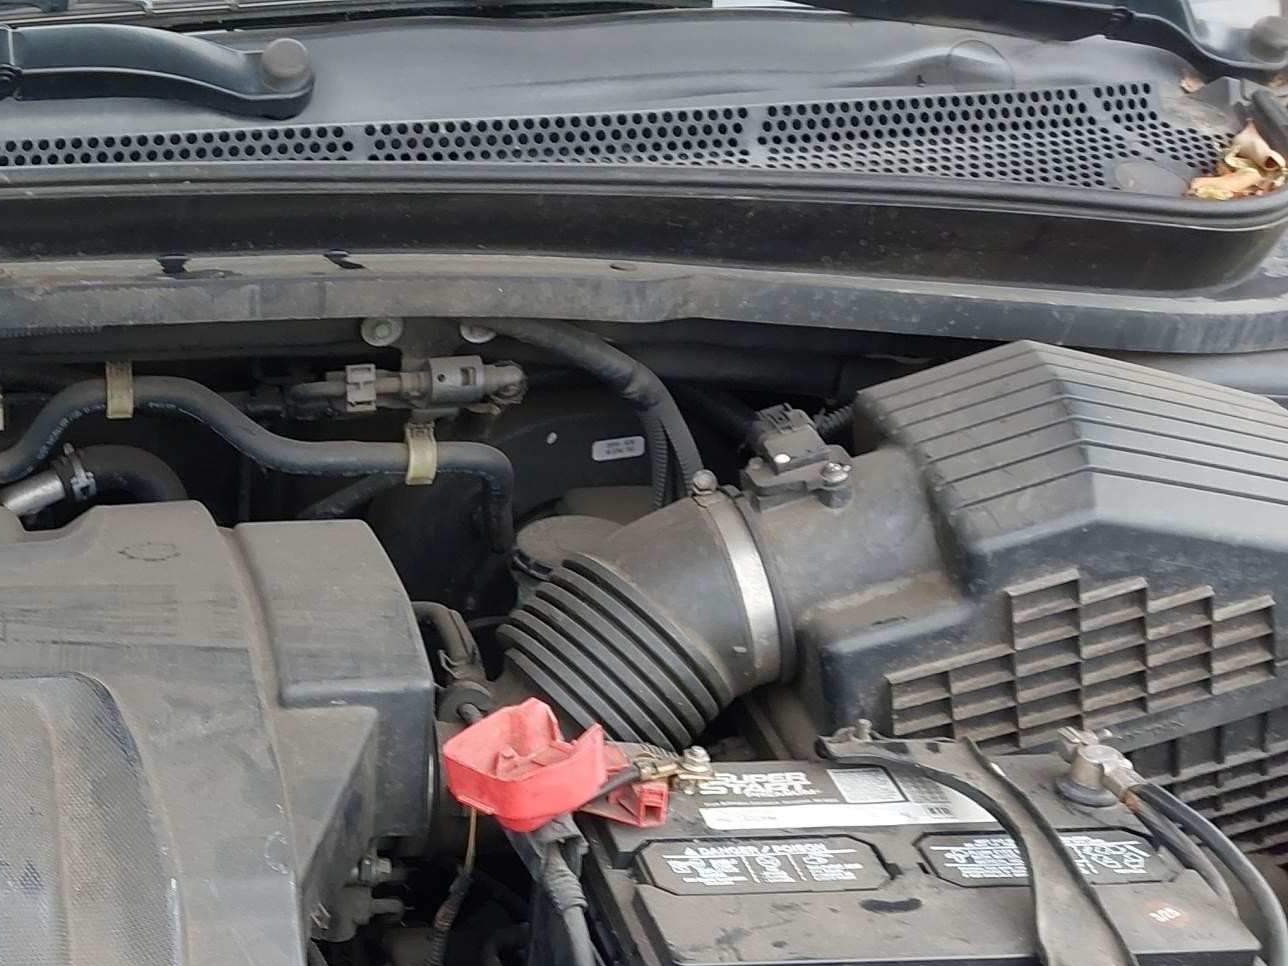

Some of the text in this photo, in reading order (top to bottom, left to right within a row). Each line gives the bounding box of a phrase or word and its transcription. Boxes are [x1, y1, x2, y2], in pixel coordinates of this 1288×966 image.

[713, 771, 813, 785] SUPER
[698, 782, 804, 796] START
[697, 845, 760, 857] DANGER
[772, 842, 828, 855] POISON
